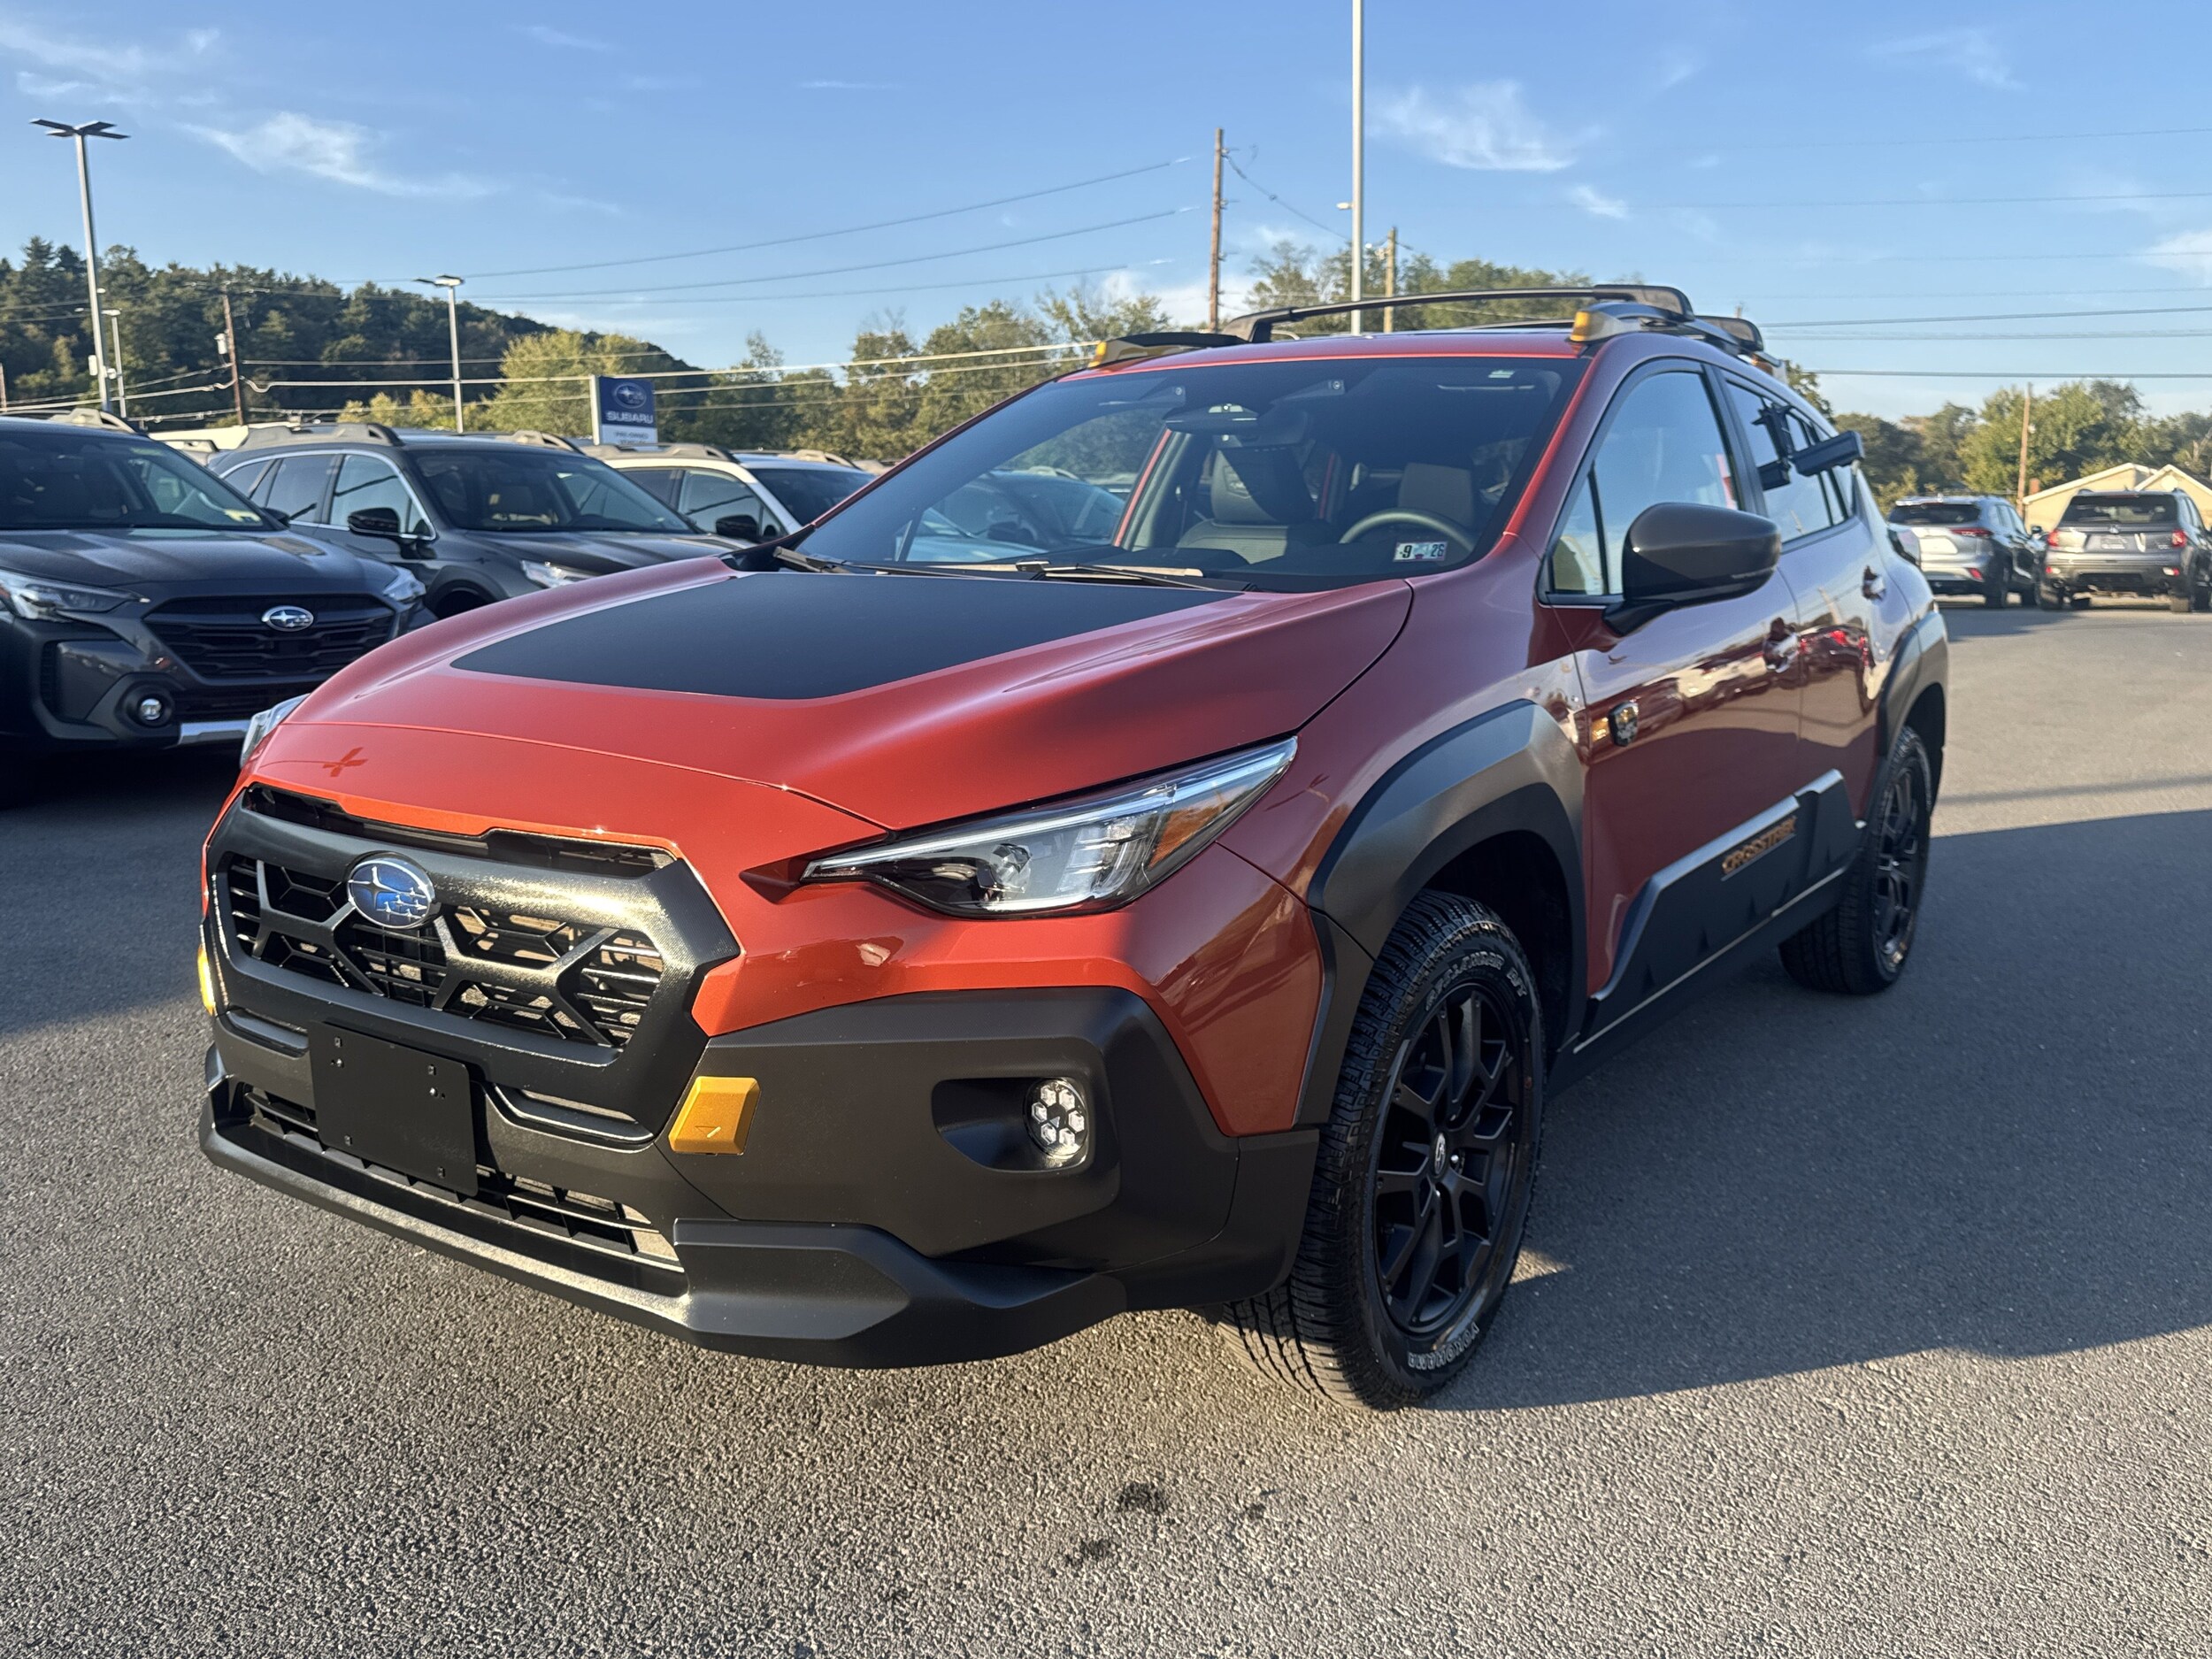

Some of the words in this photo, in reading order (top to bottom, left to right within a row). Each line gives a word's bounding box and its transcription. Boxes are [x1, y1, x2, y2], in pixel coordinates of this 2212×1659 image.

[606, 411, 653, 424] SUBARU
[1402, 545, 1412, 558] 9
[1722, 816, 1798, 874] CROSSTREK
[1425, 951, 1505, 1010] GEOLANDAR
[1507, 967, 1527, 997] A/T
[1408, 1322, 1480, 1371] YOKOHAMA
